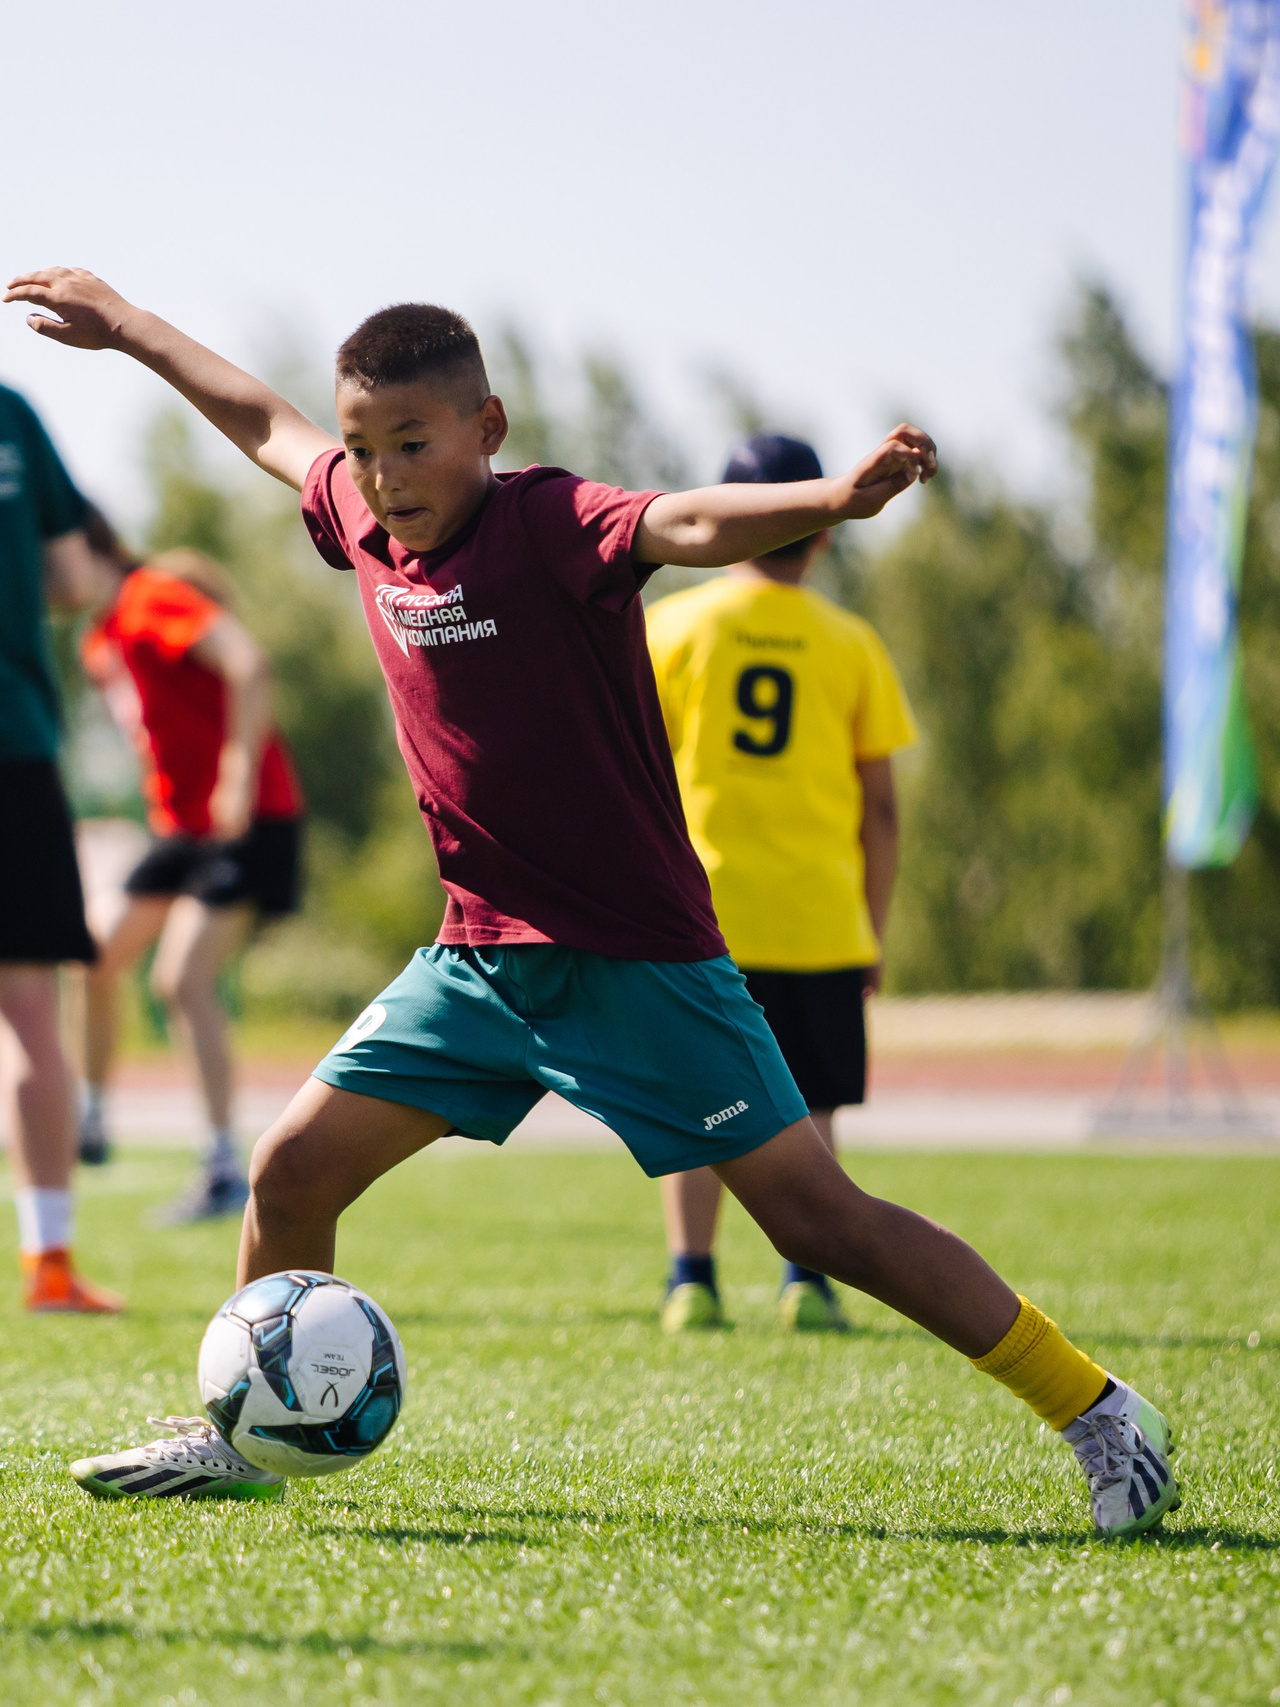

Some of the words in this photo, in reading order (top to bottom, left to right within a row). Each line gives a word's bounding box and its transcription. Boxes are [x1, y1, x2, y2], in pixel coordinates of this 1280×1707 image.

[395, 583, 464, 607] РУССКАЯ
[397, 605, 468, 628] МЕДНАЯ
[405, 619, 498, 647] КОМПАНИЯ
[733, 664, 794, 758] 9
[703, 1100, 749, 1131] Joma
[324, 1353, 345, 1361] TEAM
